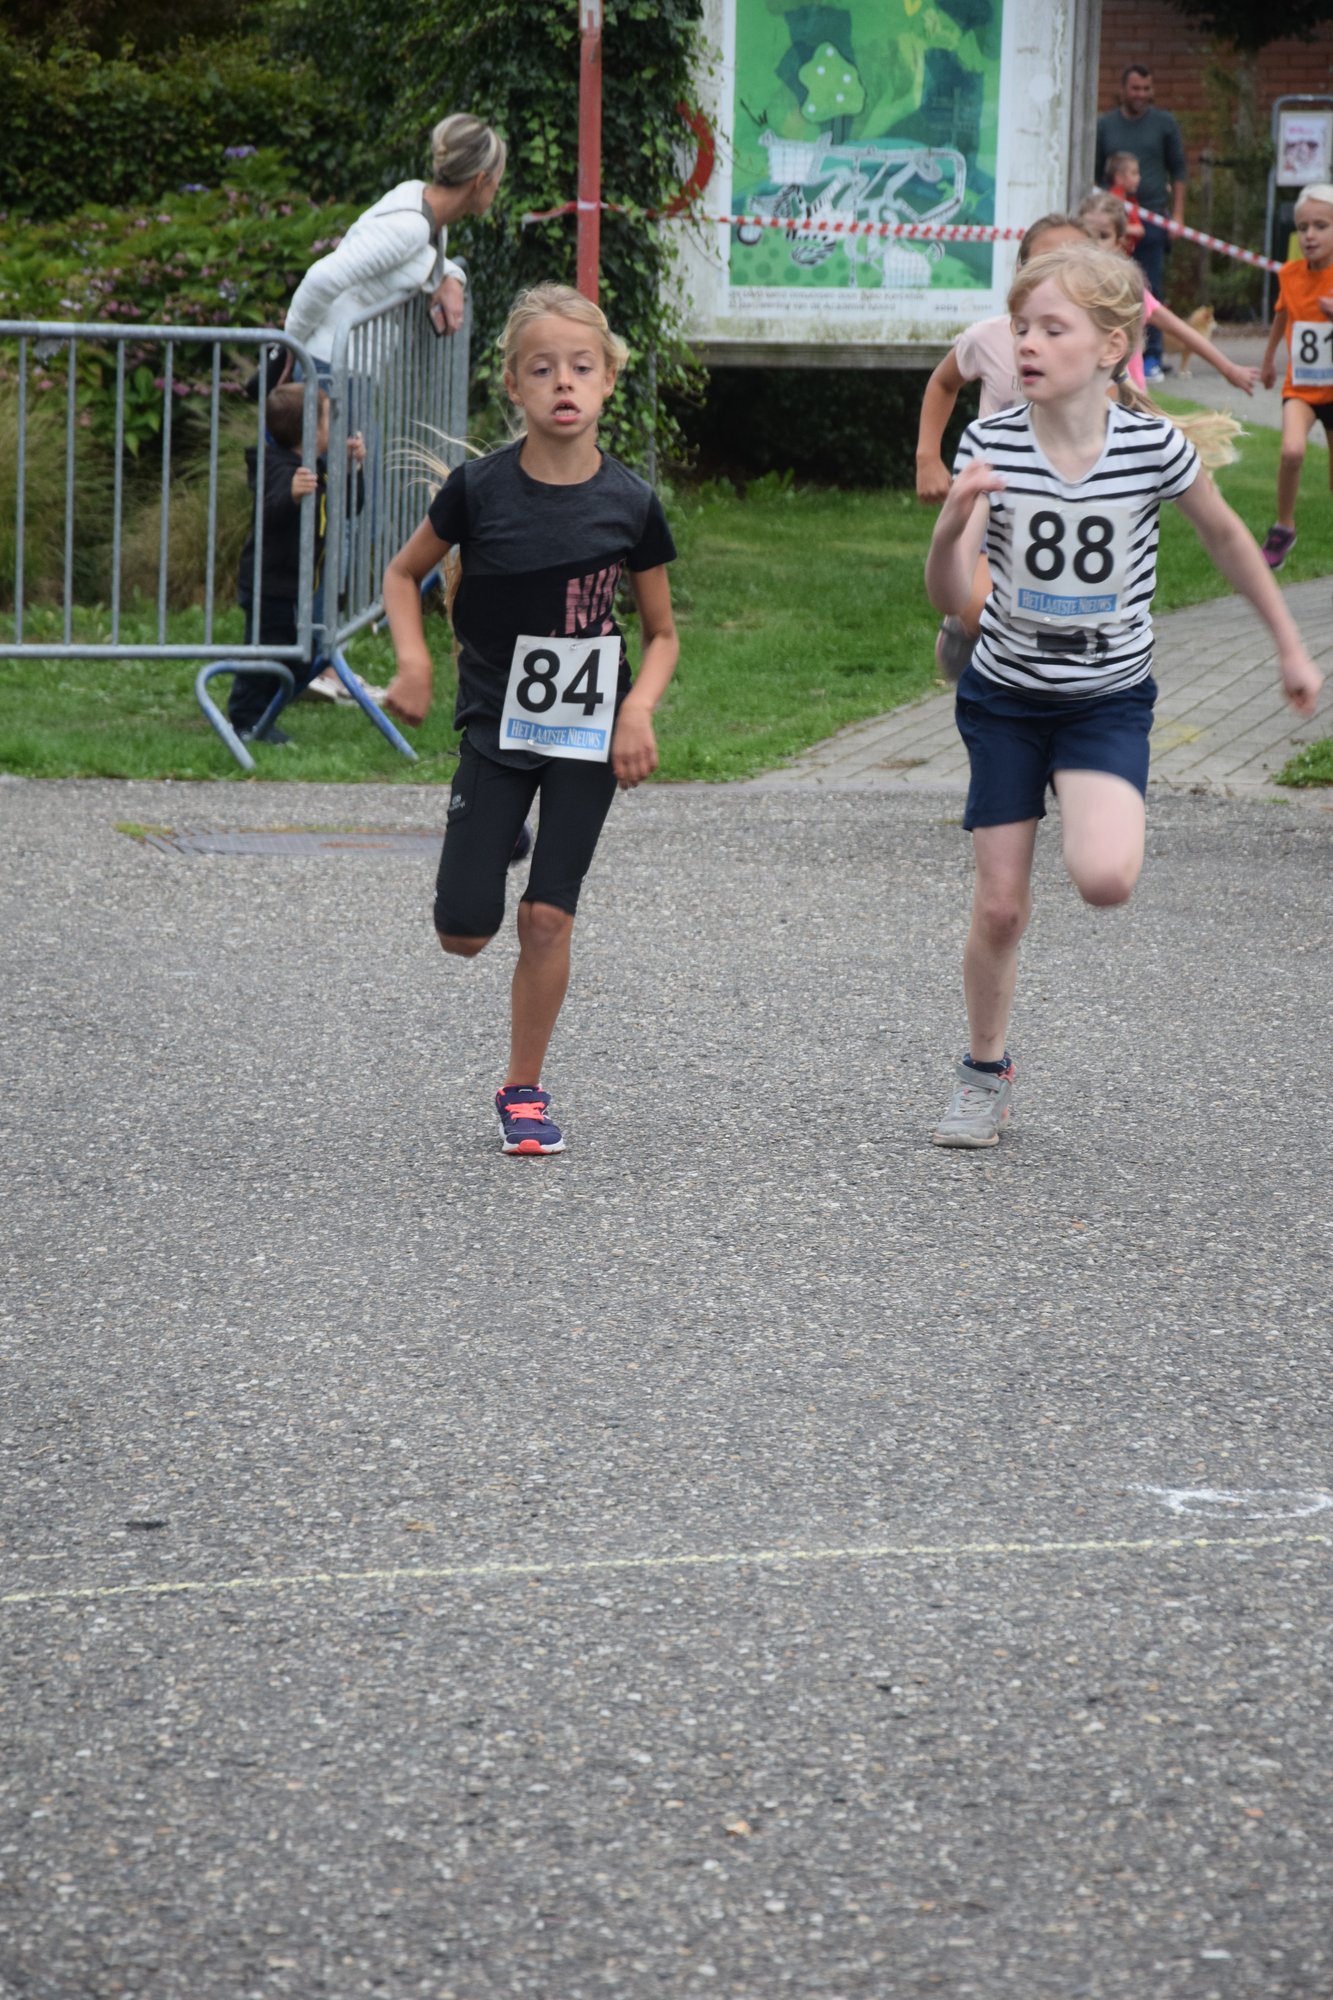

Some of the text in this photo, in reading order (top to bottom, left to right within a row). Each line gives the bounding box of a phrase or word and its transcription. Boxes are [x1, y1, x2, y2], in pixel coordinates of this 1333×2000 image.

[1025, 510, 1114, 584] 88
[1040, 594, 1077, 614] LAATSTE
[516, 648, 604, 716] 84
[511, 720, 601, 748] HET LAATSTE NIEUWS
